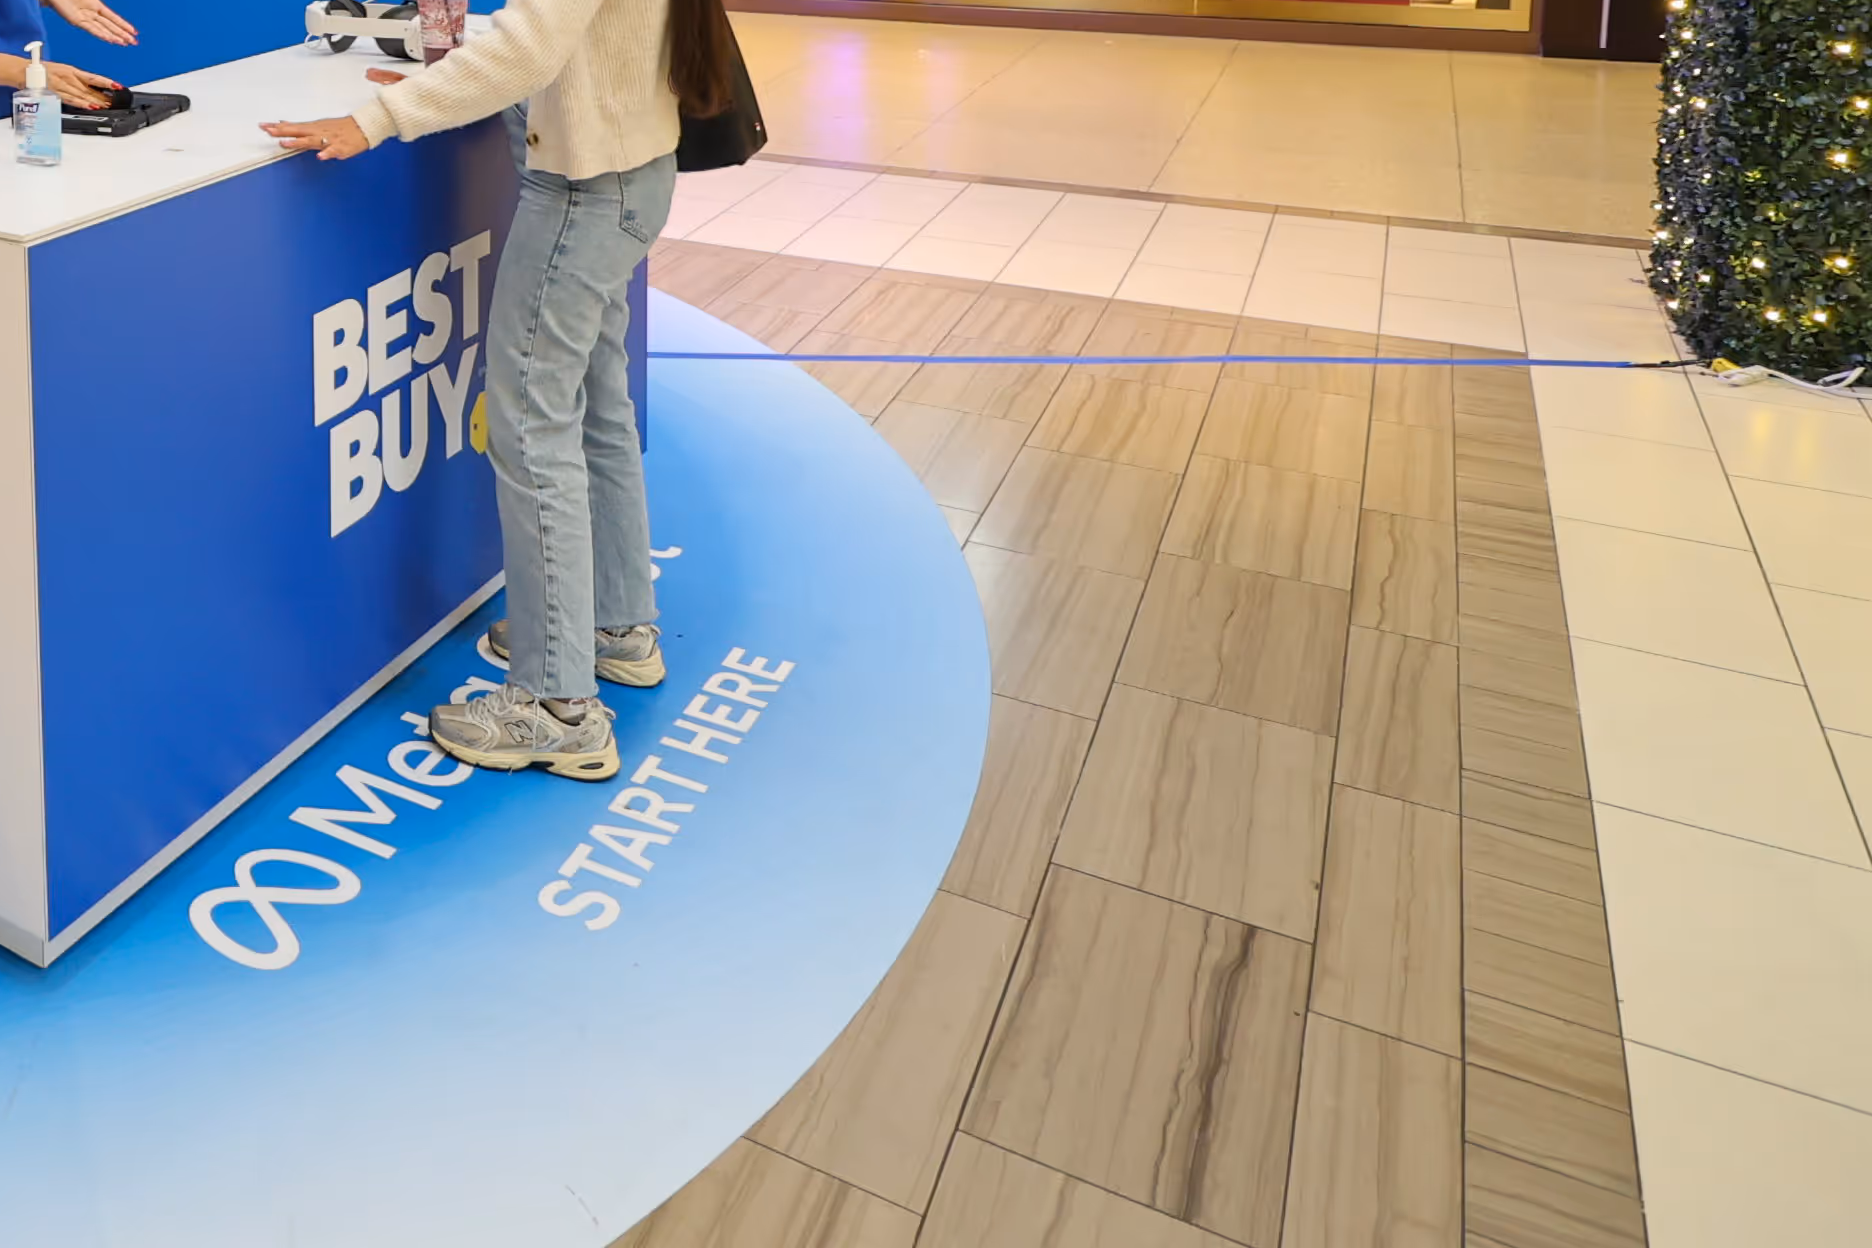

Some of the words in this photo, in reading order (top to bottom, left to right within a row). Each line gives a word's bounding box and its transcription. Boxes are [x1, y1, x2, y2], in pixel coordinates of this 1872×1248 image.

[313, 229, 491, 427] BEST
[330, 342, 479, 538] BUY
[538, 755, 709, 930] START
[659, 647, 797, 764] HERE
